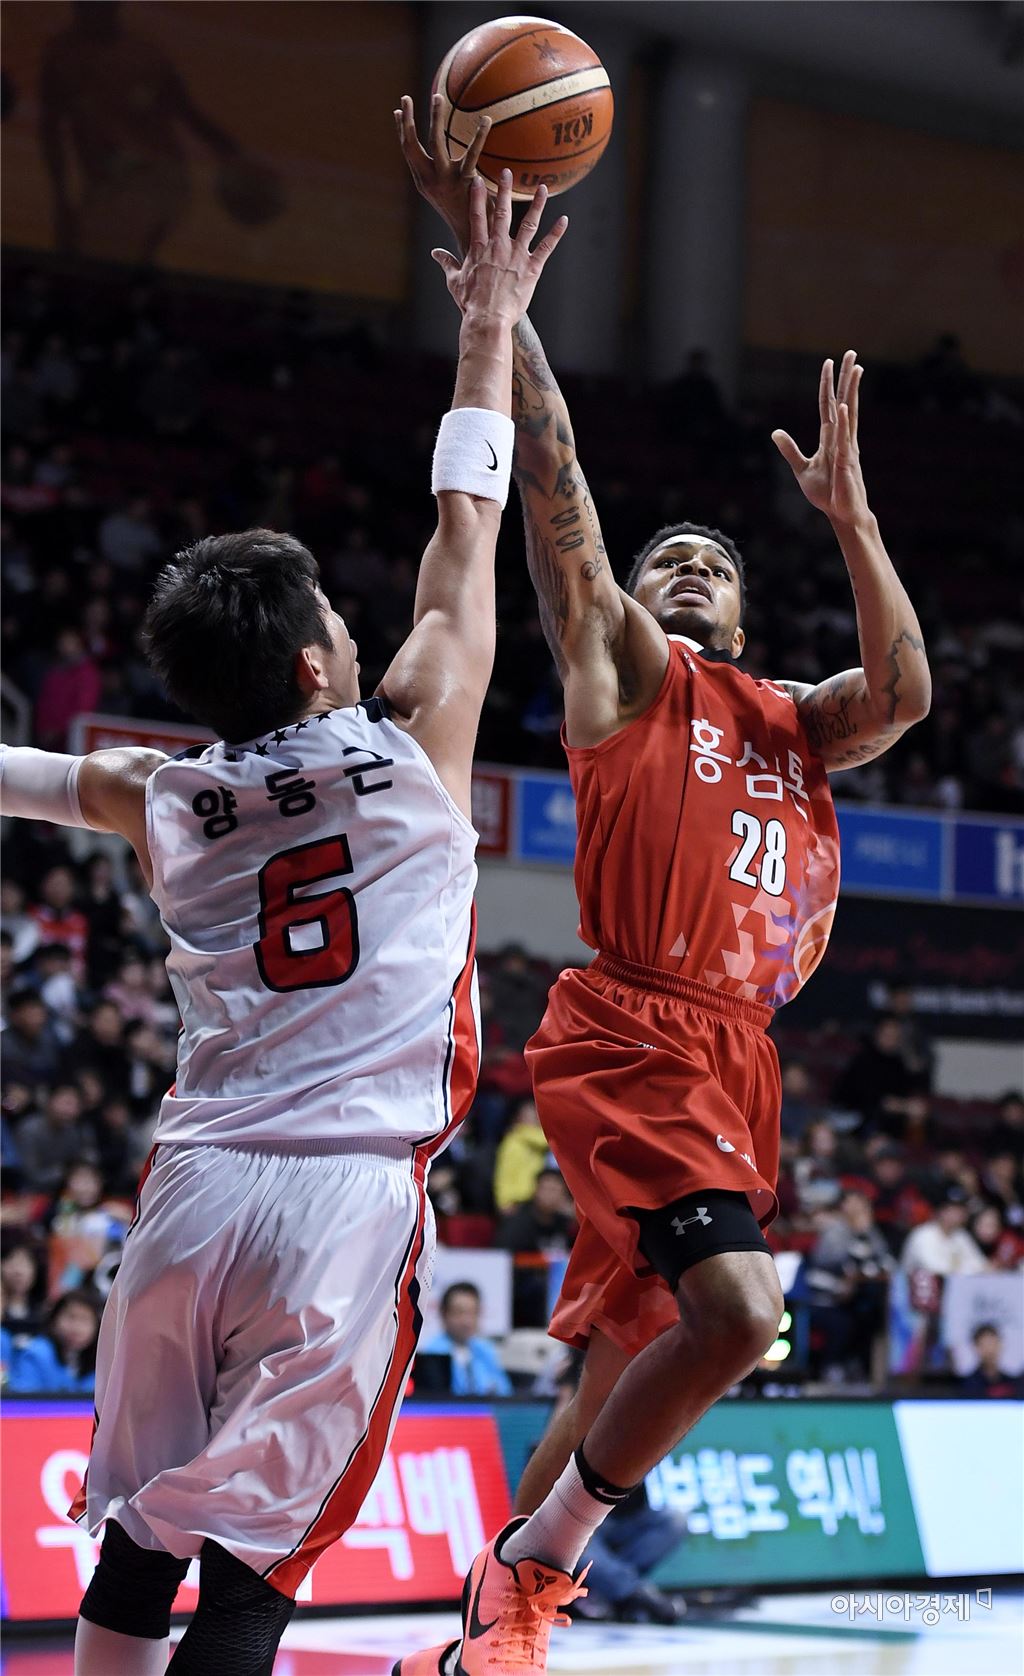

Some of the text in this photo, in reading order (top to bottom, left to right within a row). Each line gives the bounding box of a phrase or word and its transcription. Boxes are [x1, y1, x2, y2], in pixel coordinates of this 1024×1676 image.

[192, 746, 394, 840] 양동근
[729, 809, 787, 896] 28
[253, 833, 360, 992] 6
[645, 1449, 789, 1539] 보험도
